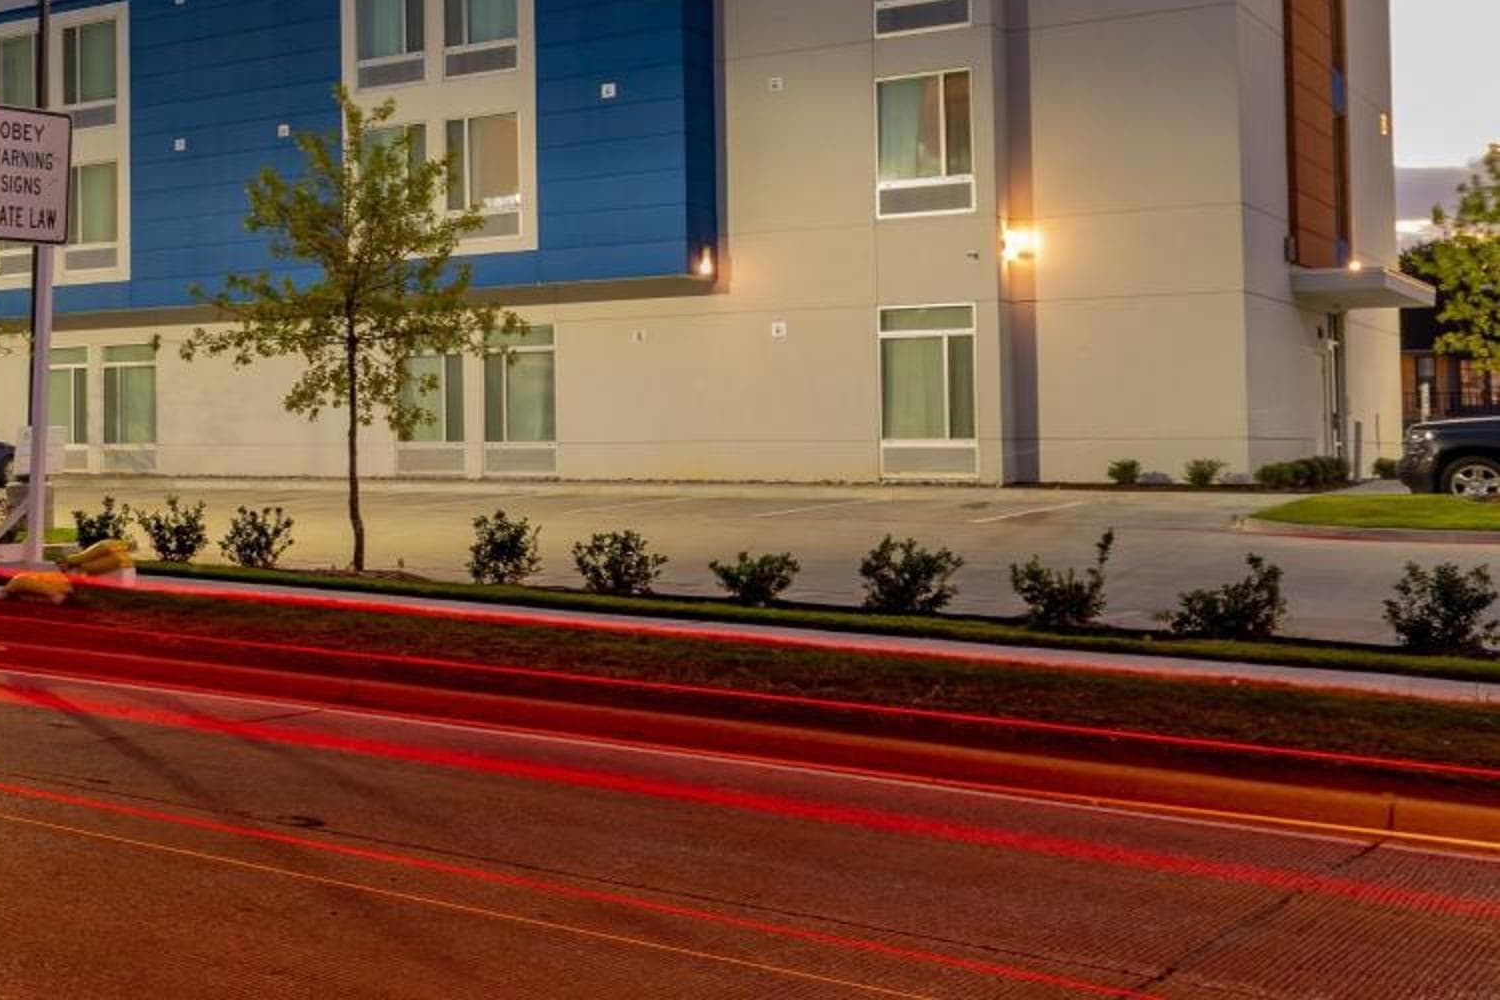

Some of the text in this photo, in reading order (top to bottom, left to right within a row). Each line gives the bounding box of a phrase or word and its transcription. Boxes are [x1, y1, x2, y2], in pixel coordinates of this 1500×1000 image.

[0, 121, 44, 142] OBEY
[1, 175, 42, 195] SIGNS
[29, 209, 57, 229] LAW
